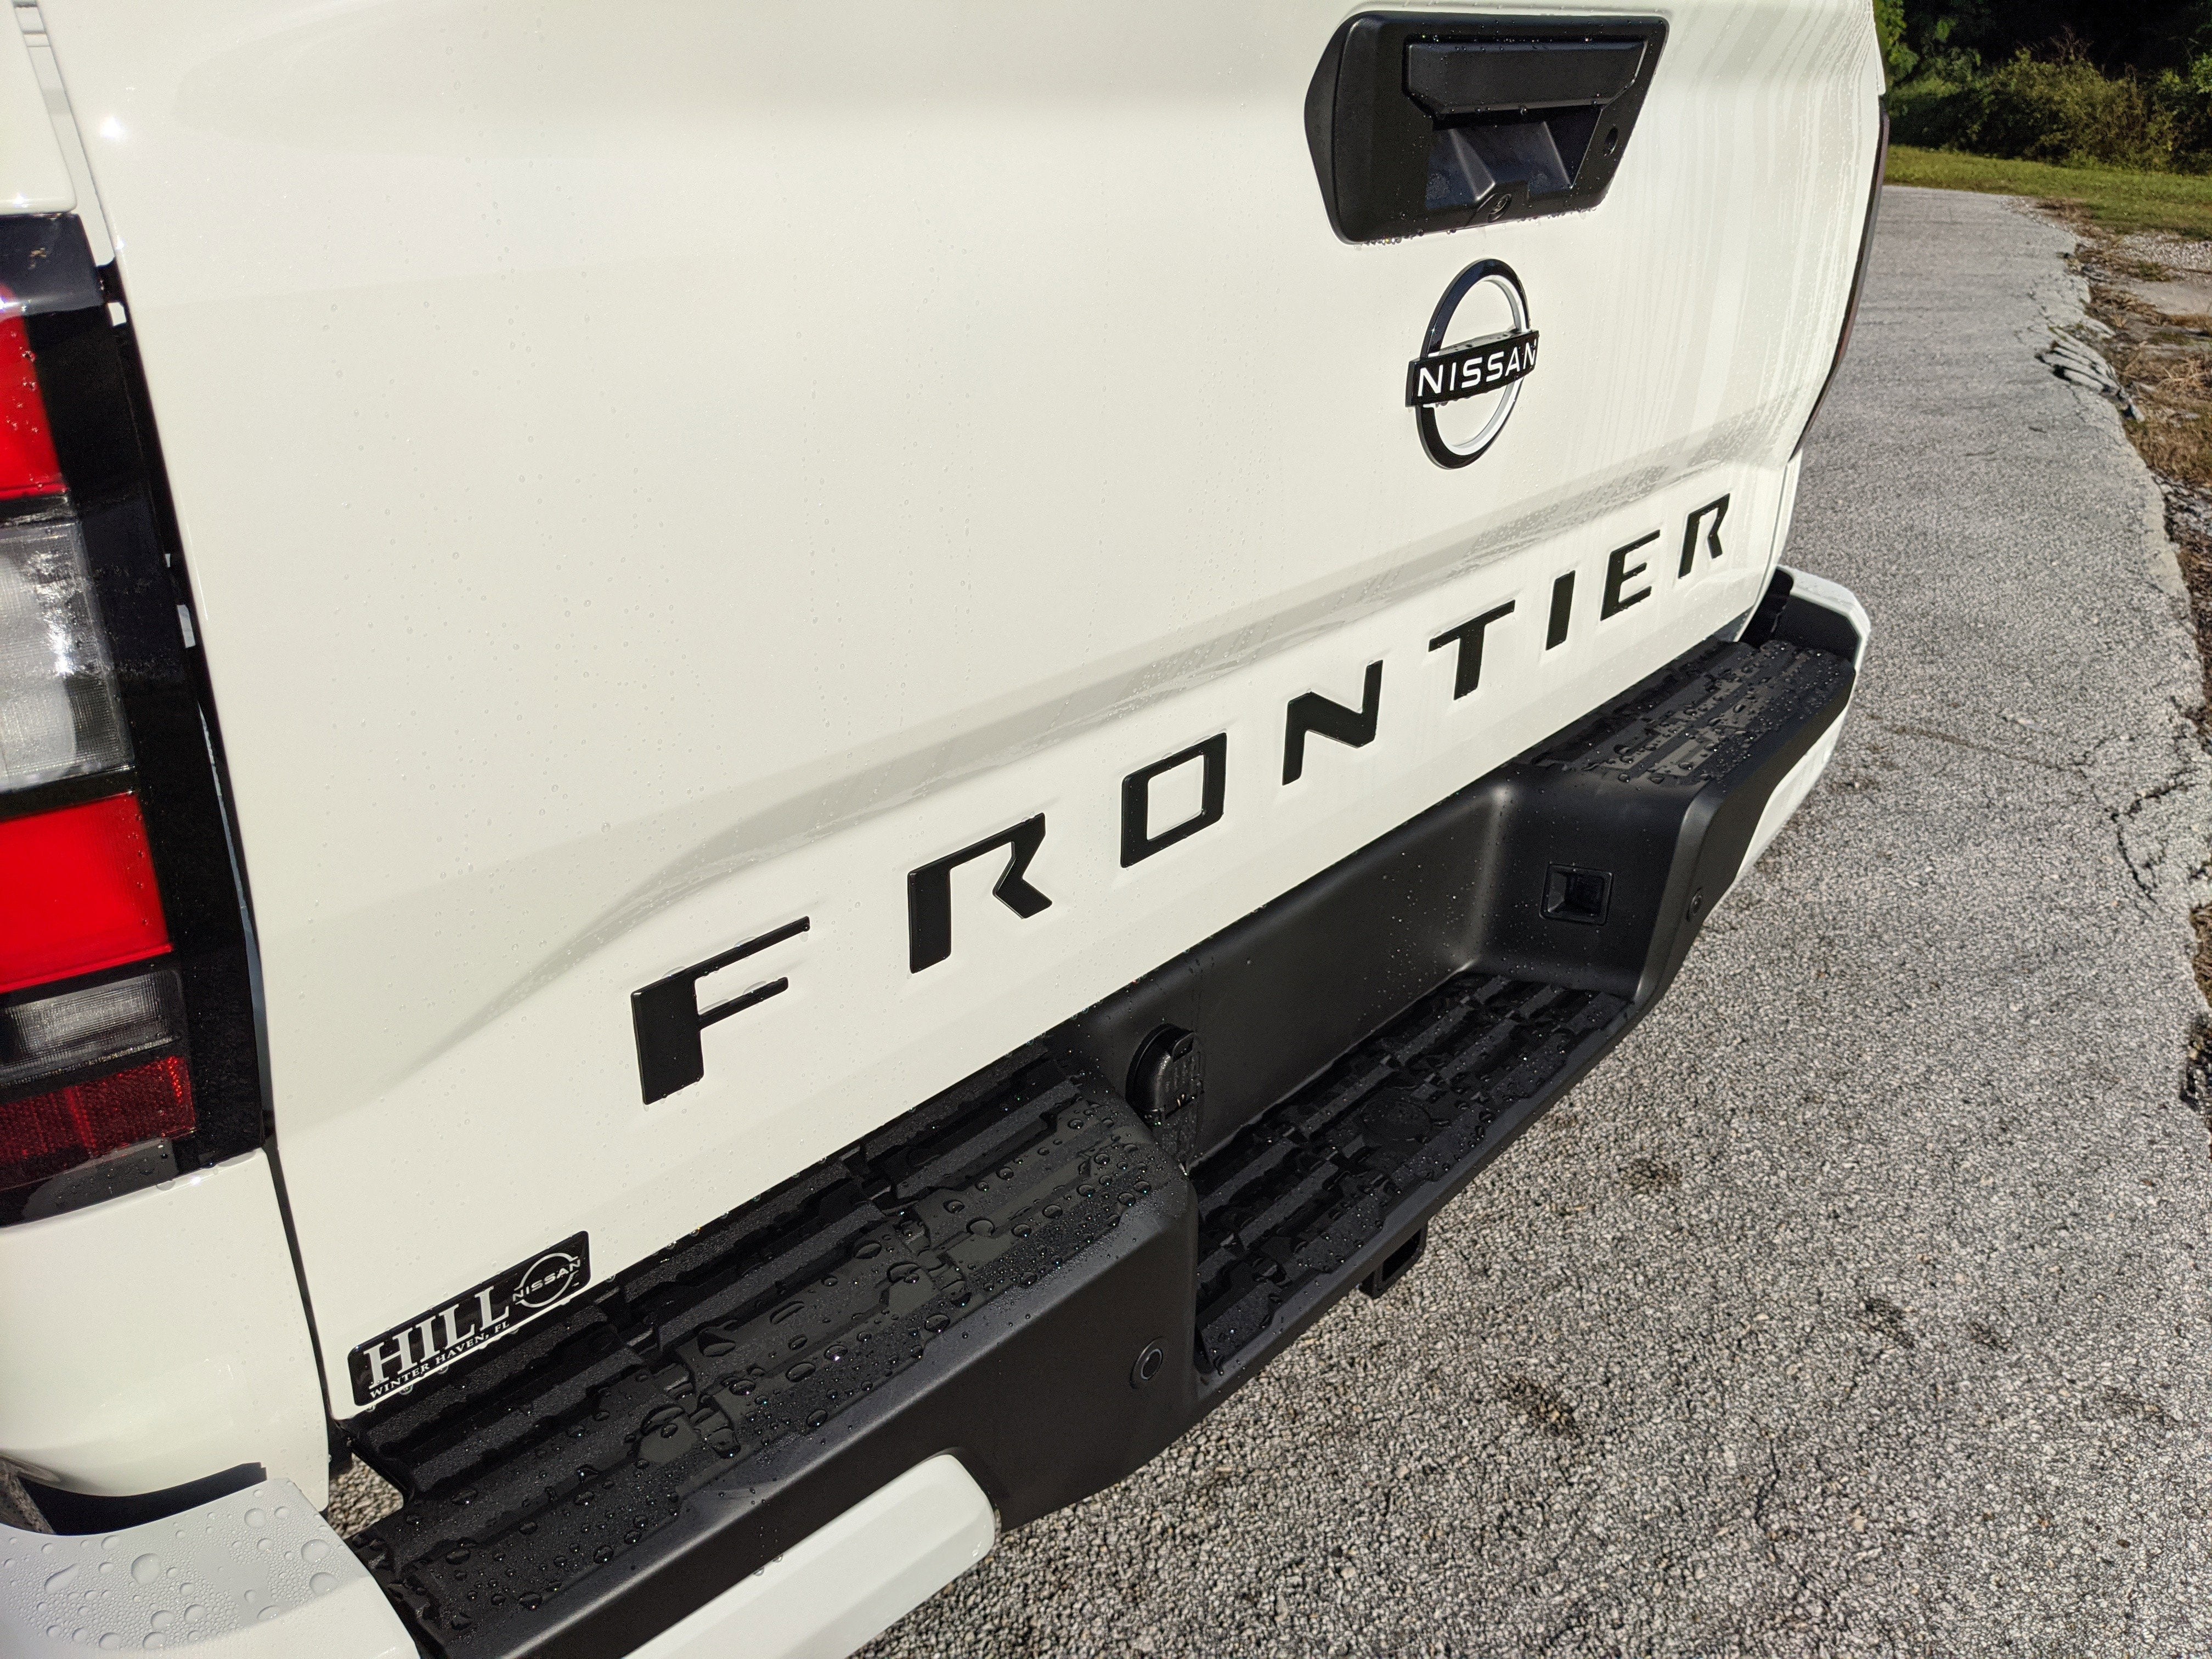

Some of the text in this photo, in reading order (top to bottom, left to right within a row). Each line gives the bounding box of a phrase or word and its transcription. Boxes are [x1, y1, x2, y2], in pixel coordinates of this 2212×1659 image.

[1418, 338, 1536, 397] NISSAN
[631, 493, 1730, 1105] FRONTIER
[512, 1259, 581, 1302] NISSAN
[363, 1286, 509, 1390] HILL
[369, 1321, 510, 1398] WINTER HAVEN, FL
